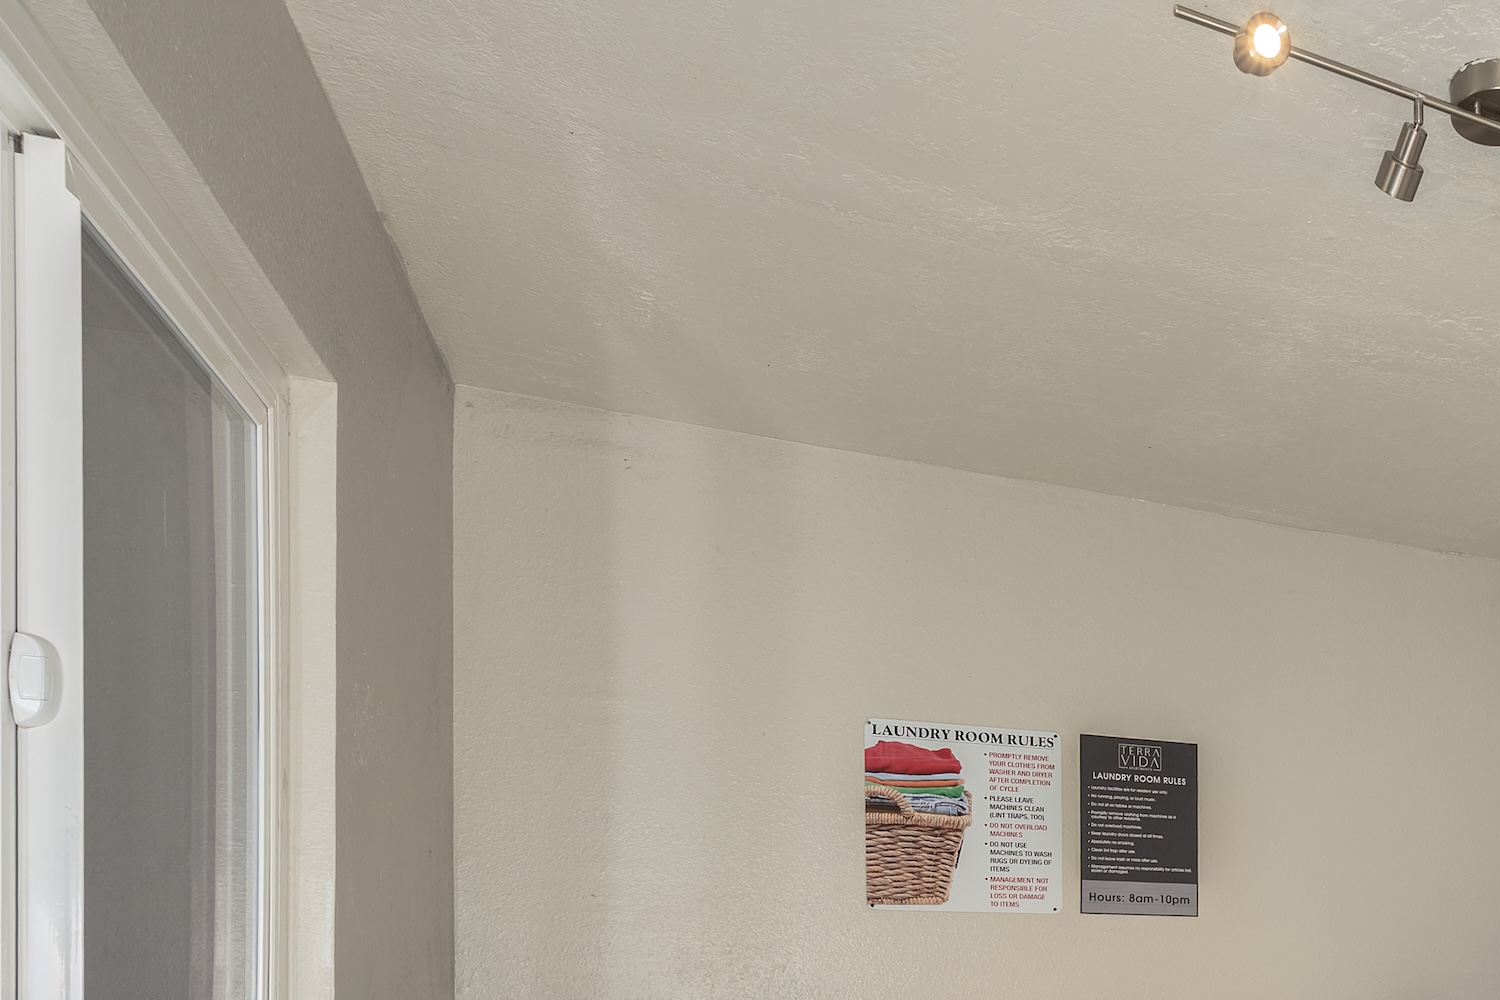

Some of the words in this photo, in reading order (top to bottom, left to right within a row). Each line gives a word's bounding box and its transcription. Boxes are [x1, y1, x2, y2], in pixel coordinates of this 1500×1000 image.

[872, 724, 951, 740] LAUNDRY
[955, 730, 1002, 744] ROOM
[1008, 736, 1054, 748] RULES
[989, 752, 1022, 760] PROMPTLY
[1121, 746, 1159, 757] TERRA
[1121, 755, 1159, 768] VIDA
[1011, 778, 1050, 786] COMPLETION
[1093, 772, 1131, 782] LAUNDRY
[1134, 775, 1160, 784] ROOM
[1163, 777, 1186, 786] RULES
[1089, 892, 1125, 902] Hours:
[1129, 894, 1190, 905] 8am-10pm
